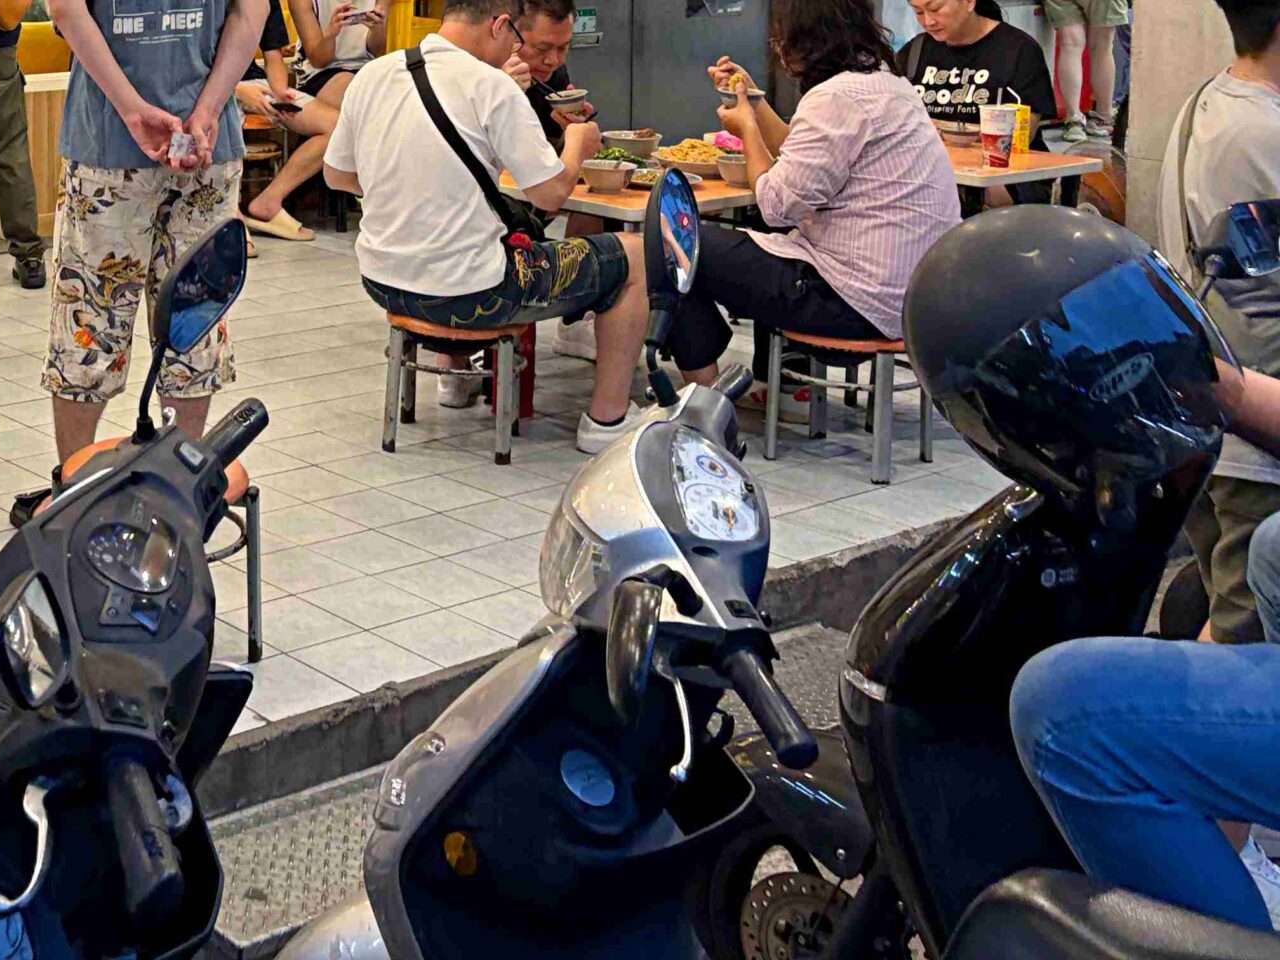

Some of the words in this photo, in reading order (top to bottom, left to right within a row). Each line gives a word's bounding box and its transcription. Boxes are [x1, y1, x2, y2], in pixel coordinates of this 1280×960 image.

[112, 17, 144, 35] ONE
[162, 11, 204, 31] PIECE
[921, 66, 990, 85] Retro
[956, 105, 977, 114] Font
